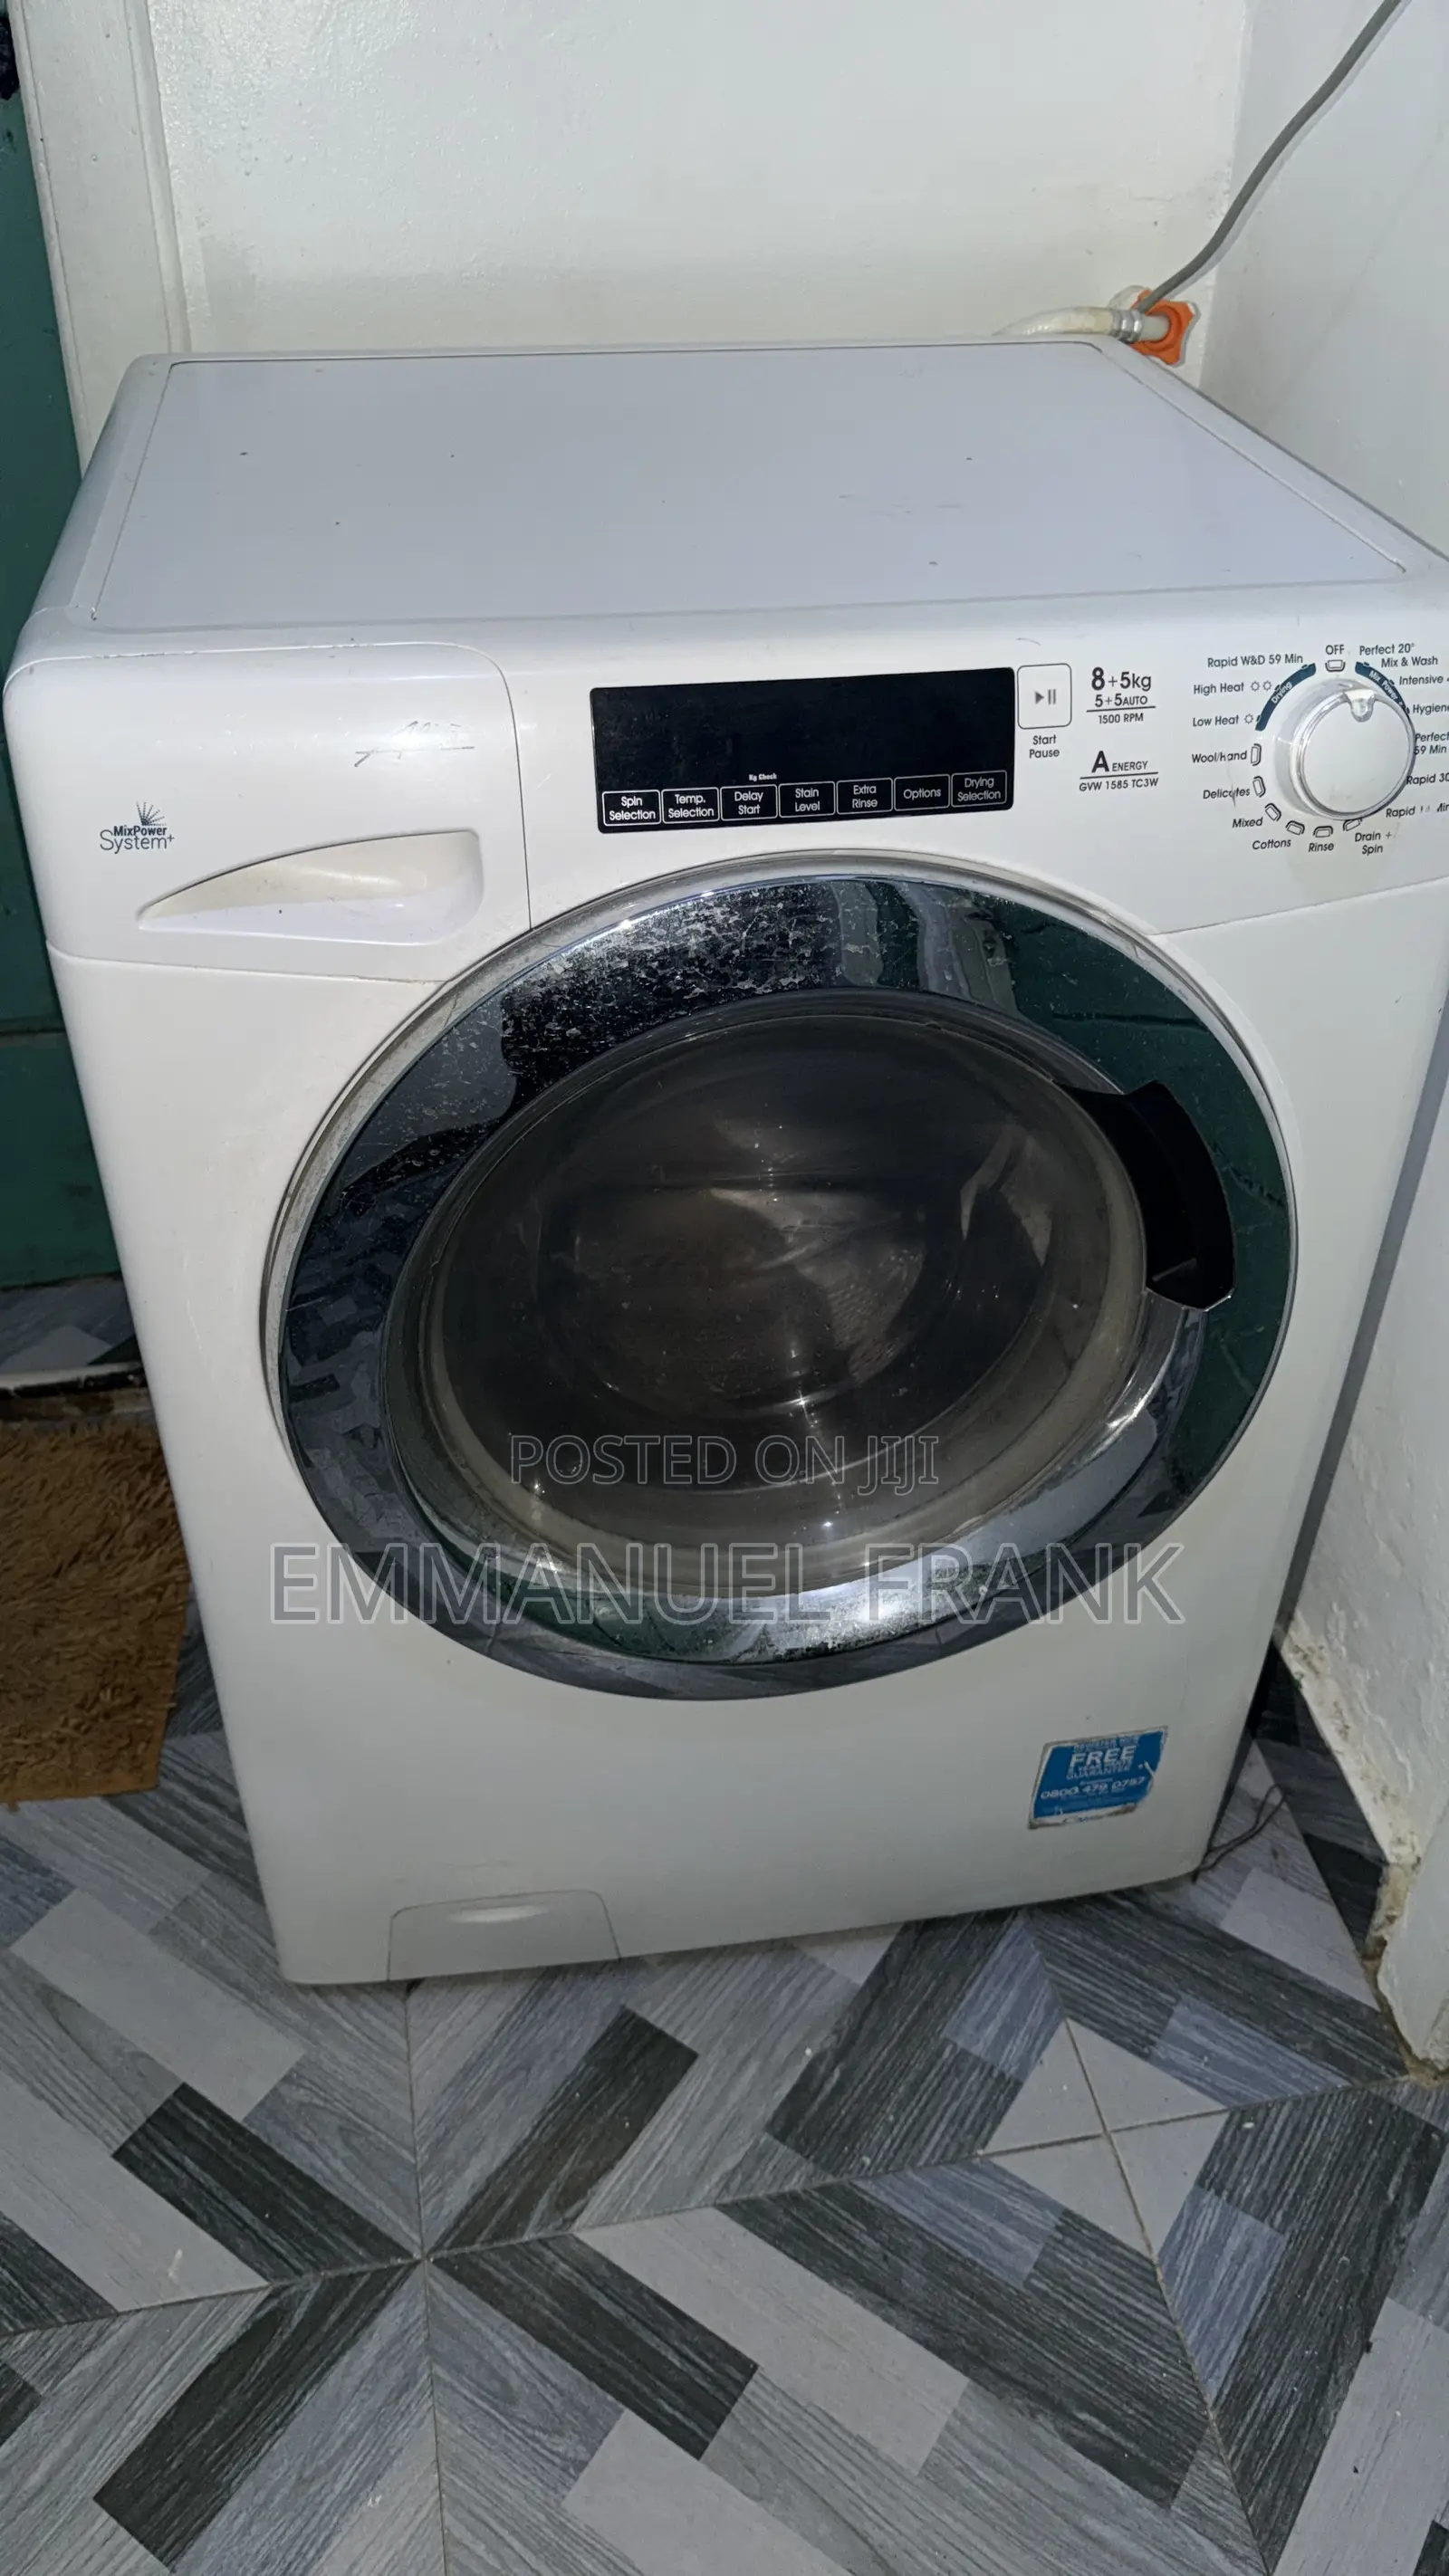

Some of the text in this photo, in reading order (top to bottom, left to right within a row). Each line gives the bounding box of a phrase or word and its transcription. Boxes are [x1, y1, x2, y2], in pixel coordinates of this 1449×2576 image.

[1325, 644, 1345, 656] OFF
[1358, 644, 1396, 656] Perfect
[1207, 654, 1304, 668] Rapid W&D 59 Min
[1380, 656, 1439, 668] Mix & Wash
[1398, 674, 1444, 685] Intensive
[1193, 682, 1244, 696] High Heat
[1271, 682, 1293, 704] Drying
[1098, 713, 1144, 724] 1500 RPM
[1192, 714, 1240, 727] Low Heat
[1032, 734, 1057, 745] Start
[1029, 748, 1060, 759] Pause
[1429, 743, 1447, 755] Min
[1091, 750, 1148, 773] A ENERGY
[964, 776, 994, 790] Drying
[1079, 777, 1159, 791] GVW 1585 TC3W
[1406, 773, 1436, 786] Rapid
[794, 788, 820, 799] Stain
[853, 784, 878, 795] Extra
[903, 787, 942, 800] Options
[674, 794, 706, 807] Temp.
[734, 790, 764, 804] Delay
[956, 790, 1002, 802] Selection
[620, 796, 643, 809] Spin
[794, 800, 820, 812] Level
[851, 798, 878, 809] Rinse
[609, 809, 657, 821] Selection
[667, 806, 715, 819] Selection
[738, 804, 761, 815] Start
[1385, 805, 1416, 819] Rapid
[1232, 816, 1264, 828] Mixed
[113, 824, 168, 837] MixPower
[1354, 830, 1382, 842] Drain
[1252, 838, 1292, 850] Cottons
[1308, 841, 1335, 853] Rinse
[1361, 844, 1384, 856] Spin
[1070, 1745, 1137, 1767] FREE
